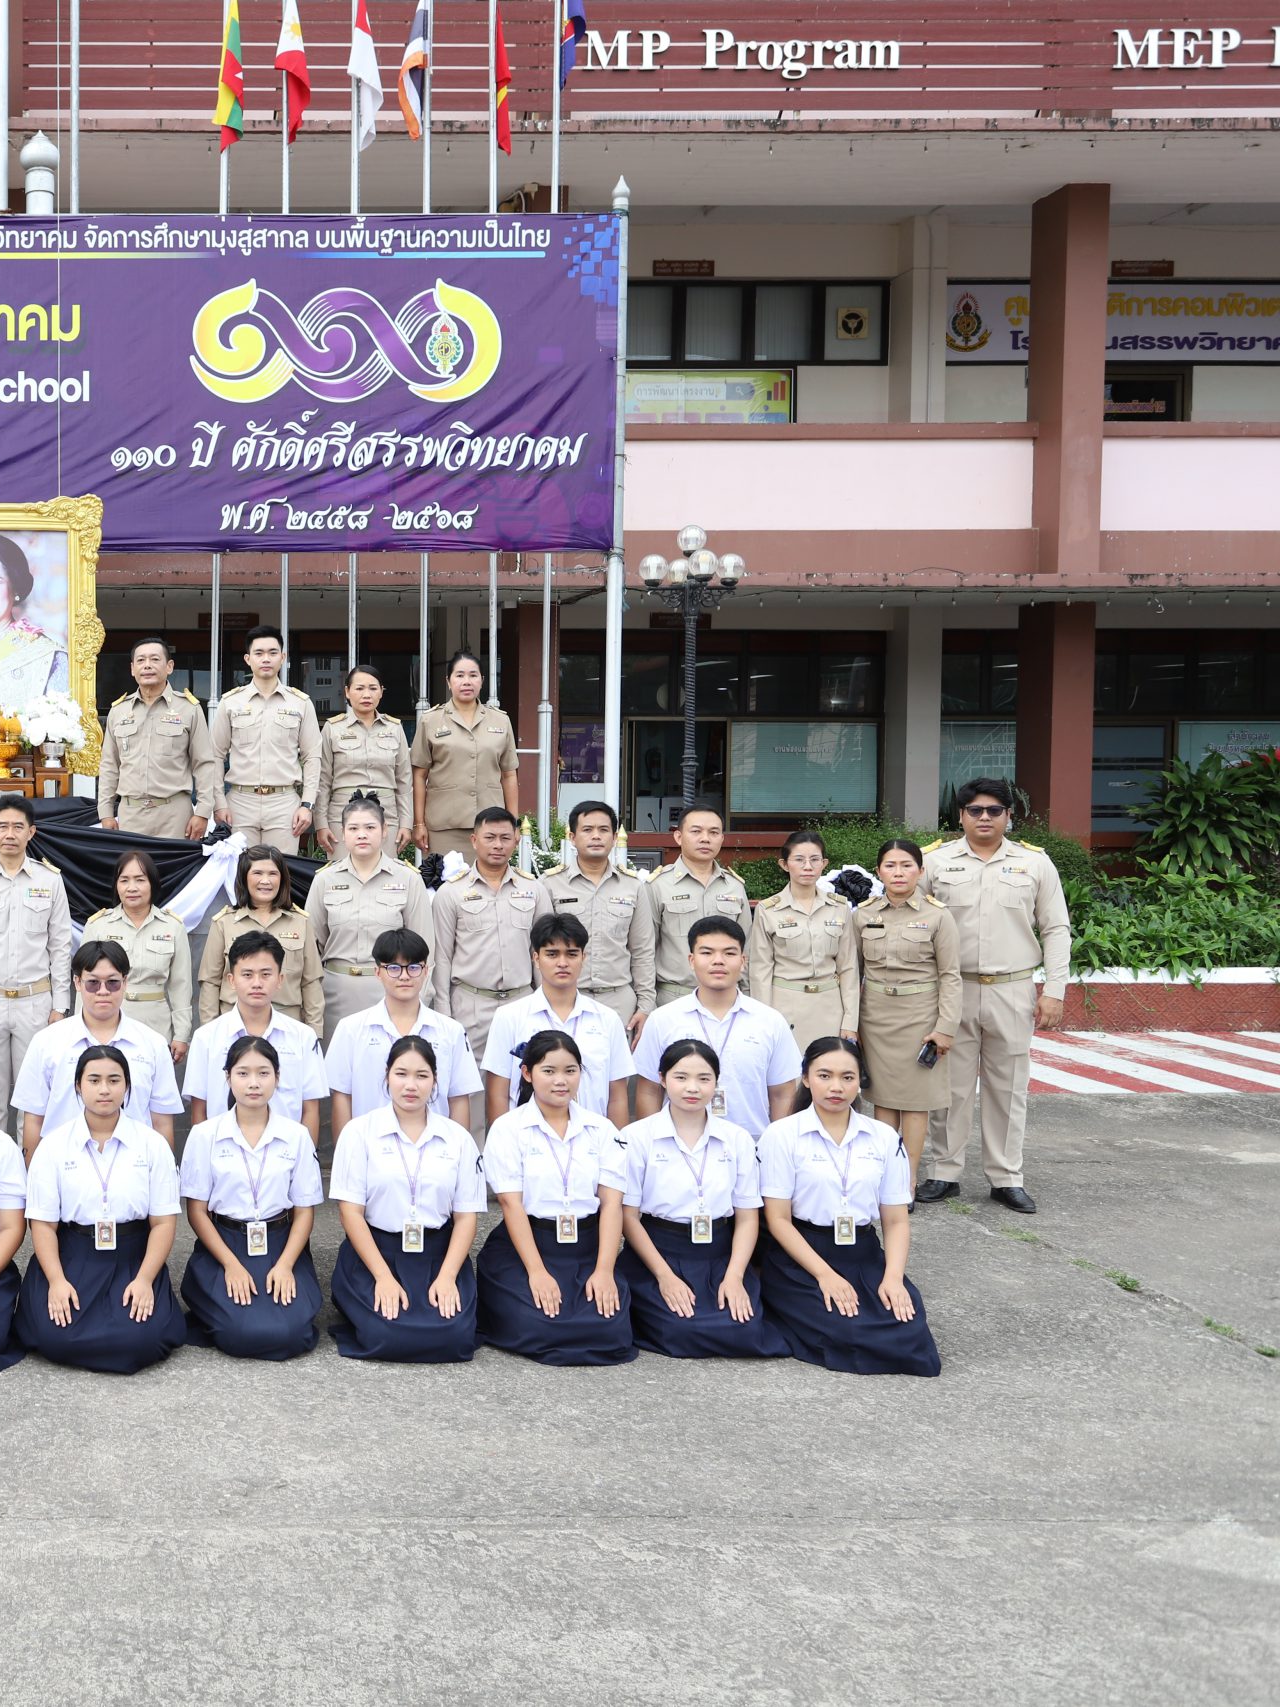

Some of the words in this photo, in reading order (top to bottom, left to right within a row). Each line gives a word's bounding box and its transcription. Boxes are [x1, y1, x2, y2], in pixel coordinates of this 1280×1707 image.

[584, 29, 671, 71] MP
[702, 29, 901, 79] Program
[1112, 27, 1241, 69] MEP
[84, 216, 309, 255] จัดการศึกษามุ่งสู่สากล
[315, 216, 551, 254] บนพื้นฐานความเป็นไทย
[190, 420, 225, 469] ปี
